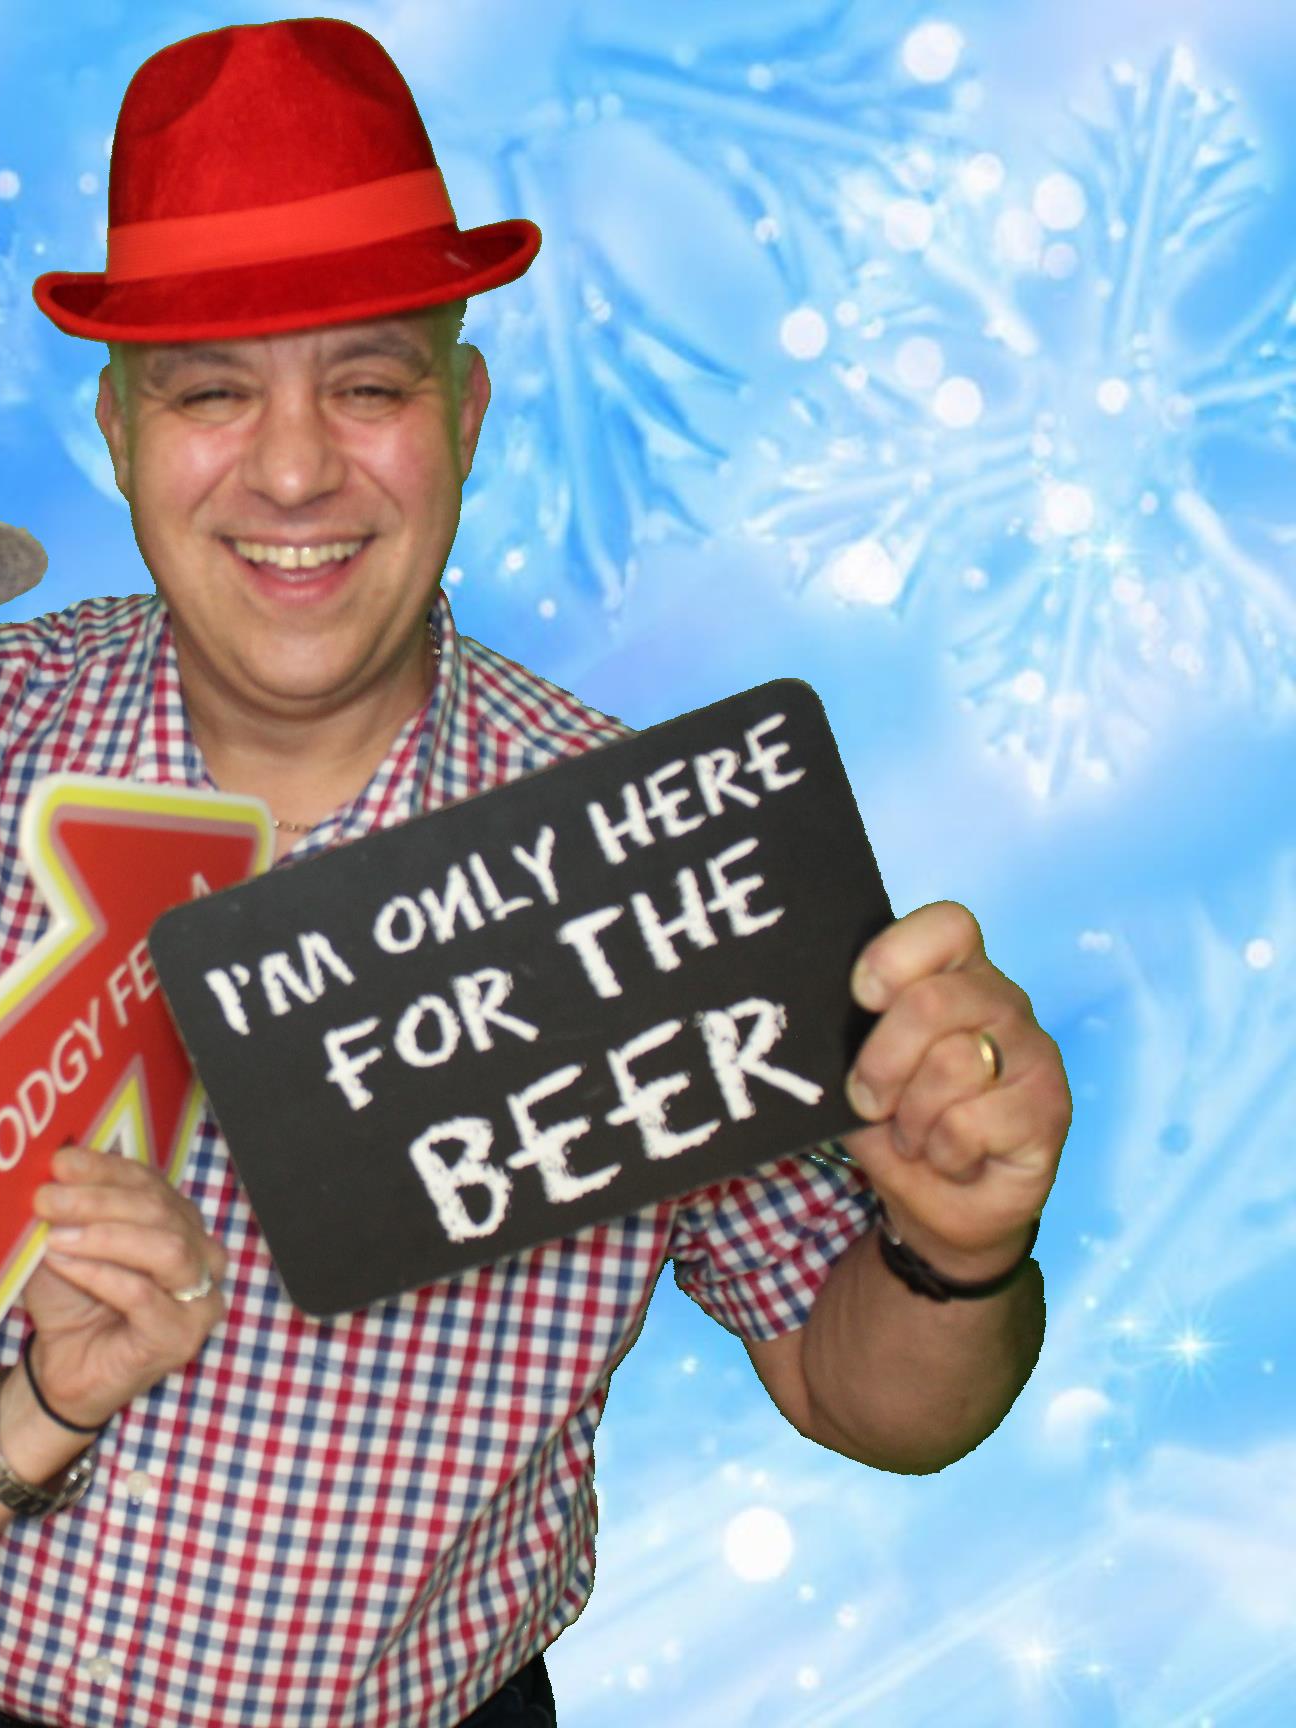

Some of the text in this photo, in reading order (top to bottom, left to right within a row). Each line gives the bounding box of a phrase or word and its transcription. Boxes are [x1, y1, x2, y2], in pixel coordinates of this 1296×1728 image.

[205, 714, 805, 1036] I'M ONLY HERE
[324, 838, 785, 1111] FOR THE
[410, 998, 824, 1243] BEER
